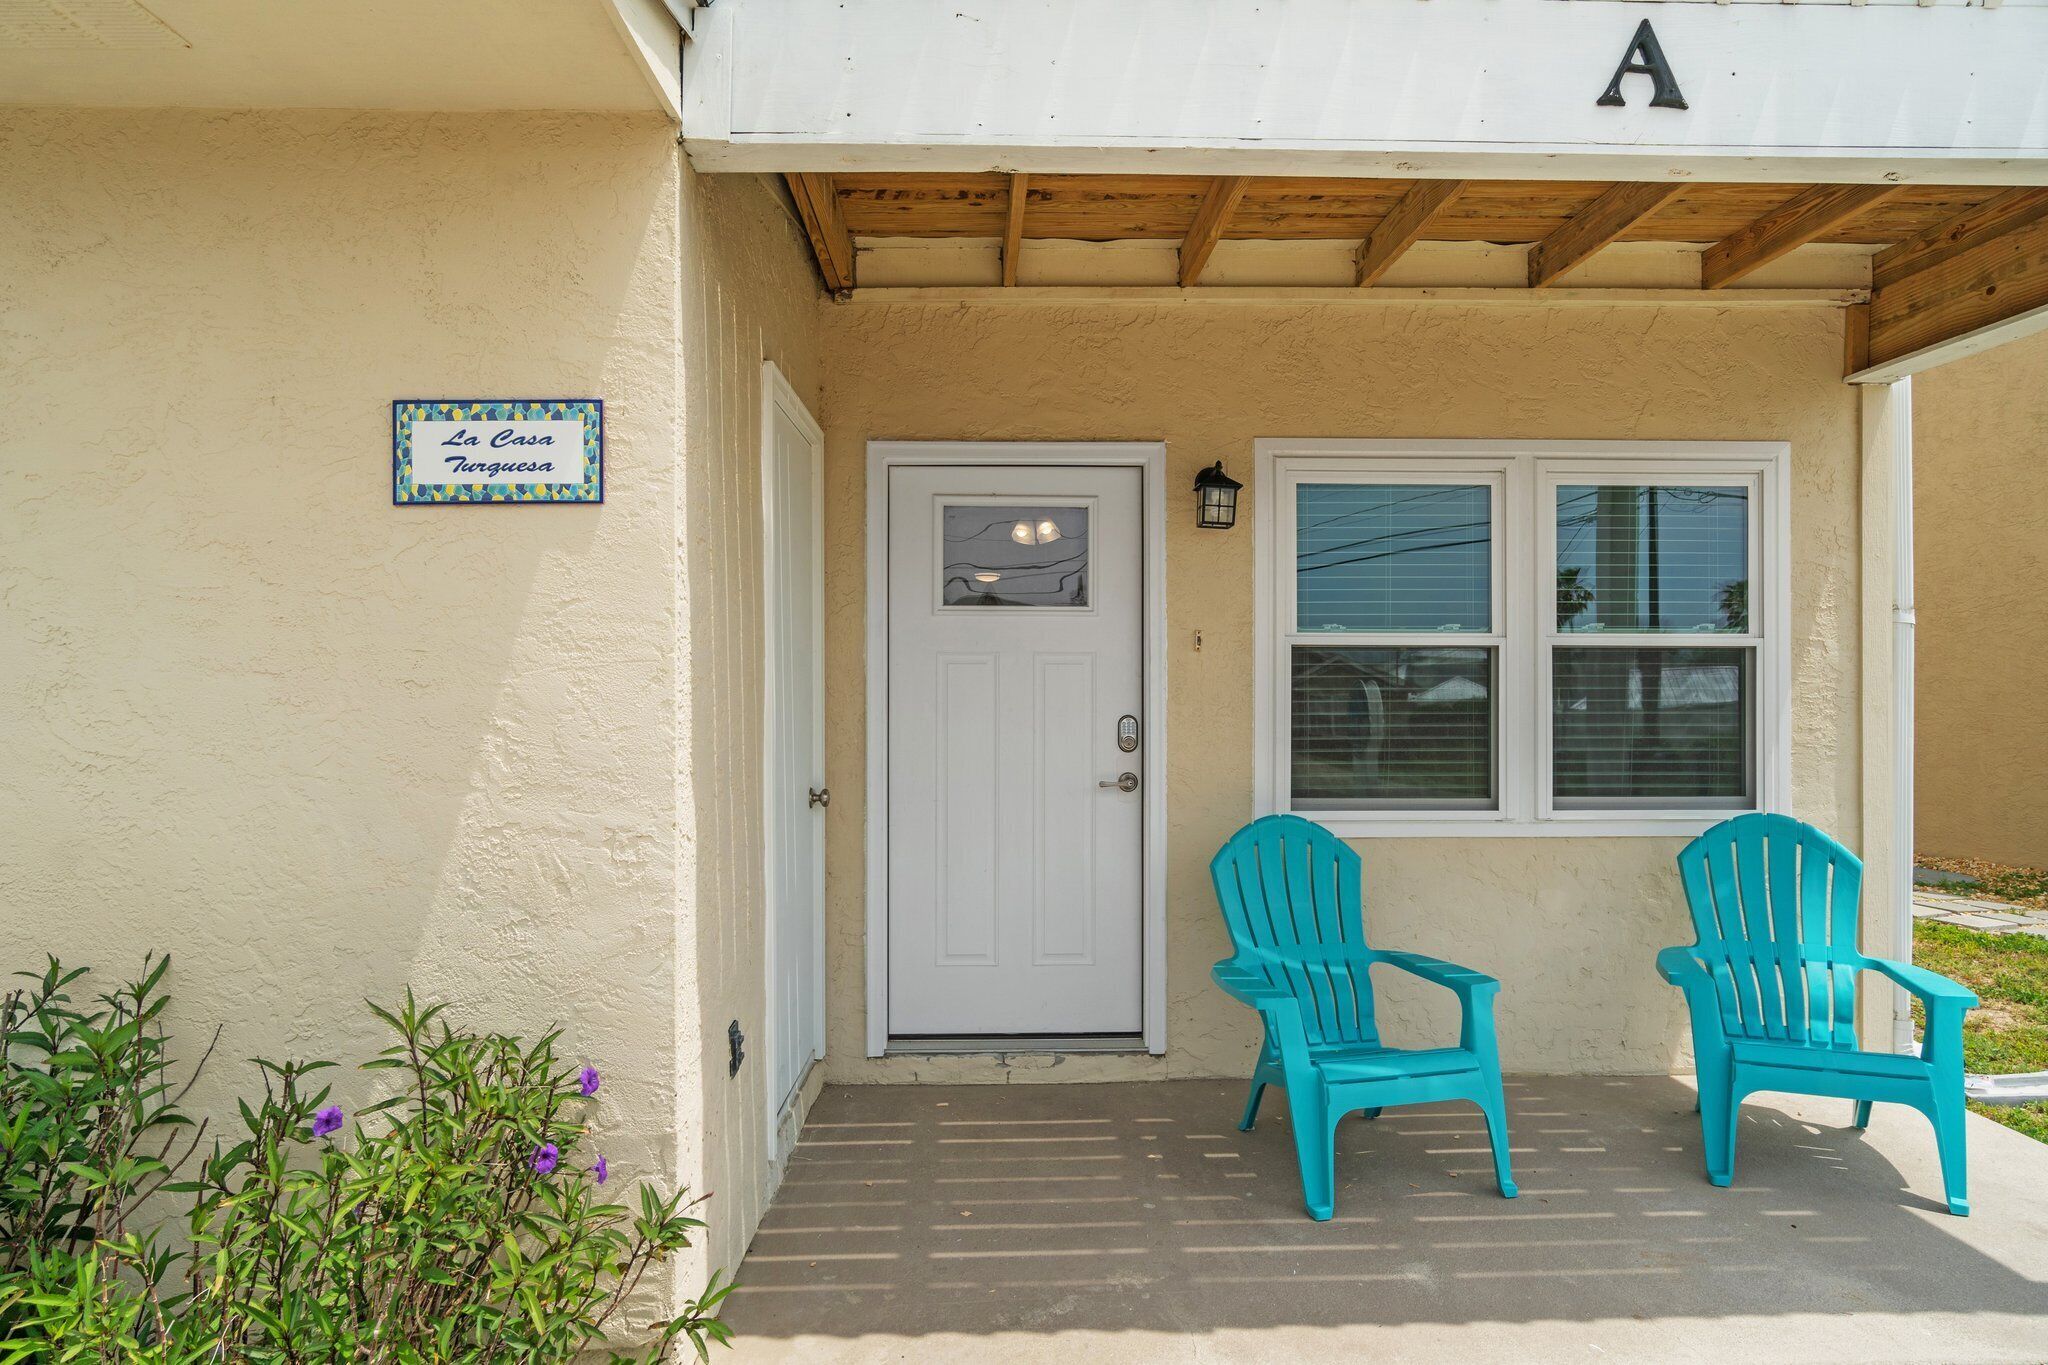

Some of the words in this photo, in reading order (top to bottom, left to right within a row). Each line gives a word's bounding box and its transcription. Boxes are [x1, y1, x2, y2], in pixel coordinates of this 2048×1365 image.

[1596, 18, 1689, 110] A
[441, 429, 480, 446] La
[490, 429, 555, 448] Casa
[444, 455, 555, 478] Turquesa
